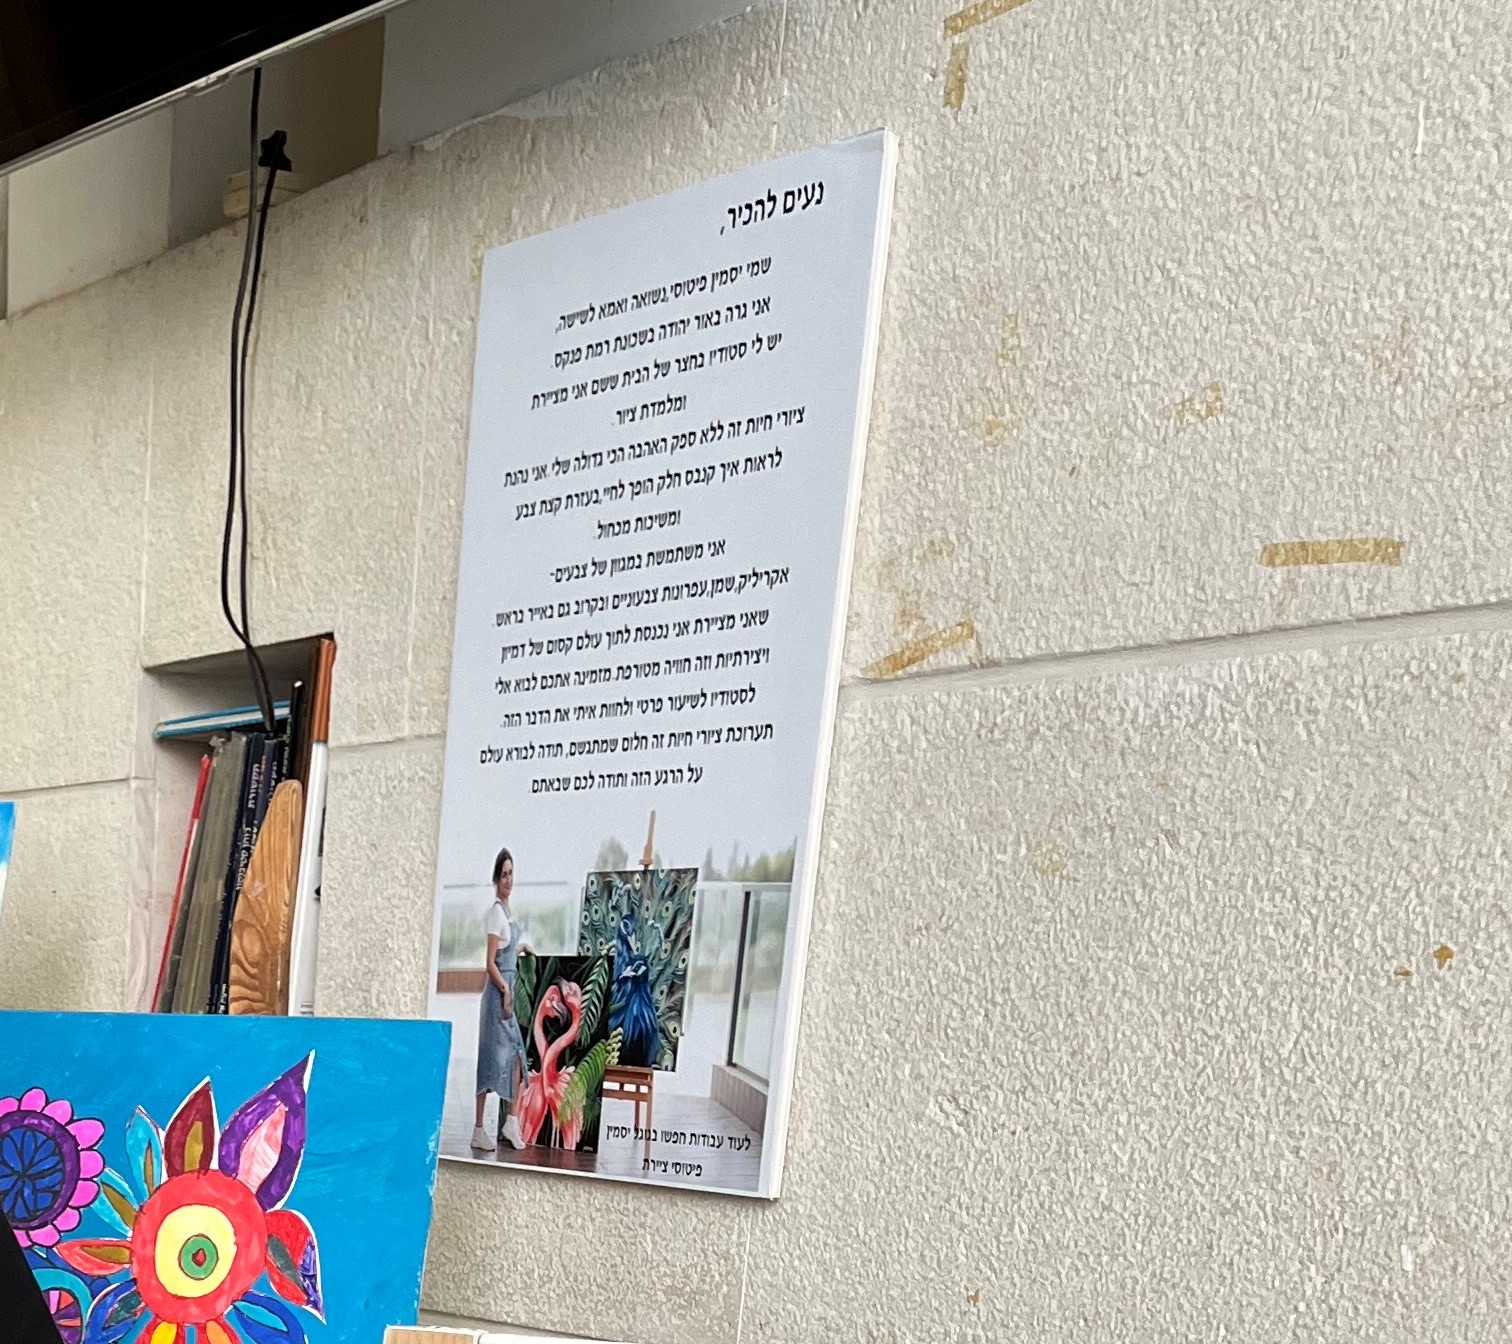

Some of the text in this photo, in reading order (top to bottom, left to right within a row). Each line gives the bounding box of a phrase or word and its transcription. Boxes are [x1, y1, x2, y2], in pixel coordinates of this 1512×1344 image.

[781, 180, 824, 214] נעים
[745, 255, 772, 278] שמי
[709, 264, 743, 293] יסמין
[597, 296, 628, 320] ואמא
[724, 301, 747, 323] גרה
[751, 294, 771, 316] אני
[657, 317, 691, 341] יהודה
[693, 308, 721, 330] באור
[584, 338, 610, 360] רמת
[612, 326, 655, 353] בשכונת
[530, 332, 782, 410] יש לי סטודיו בחצר של הבית ששם אני מציירת
[639, 392, 687, 420] ומלמדת
[776, 405, 805, 426] ציורי
[699, 419, 724, 445] ללא
[726, 419, 742, 439] זה
[743, 413, 773, 435] חיות
[627, 436, 667, 460] האהבה
[669, 430, 697, 455] ספק
[572, 449, 603, 472] גדולה
[606, 446, 625, 464] הכי
[741, 445, 783, 475] לראות
[684, 464, 716, 486] קנבס
[718, 458, 740, 483] איך
[627, 477, 654, 501] הופך
[655, 468, 681, 496] חלק
[514, 500, 537, 521] צבע
[538, 496, 562, 516] קצת
[633, 509, 681, 533] ומשיכות
[645, 542, 704, 568] משתמשת
[707, 538, 726, 557] אני
[590, 556, 607, 577] של
[609, 553, 642, 577] במגוון
[572, 595, 609, 617] ובקרוב
[611, 586, 659, 610] צבעוניים
[556, 601, 571, 618] גם
[500, 608, 769, 664] שאני מציירת אני נכנסת לתוך עולם קסום של דמיון
[663, 656, 692, 675] חוויה
[693, 654, 712, 671] וזה
[714, 646, 770, 669] ויצירתיות
[494, 675, 512, 695] אלי
[513, 671, 538, 693] לבוא
[539, 671, 571, 690] אתכם
[636, 696, 663, 714] פרטי
[666, 687, 707, 712] לשיעור
[709, 681, 756, 707] לסטודיו
[524, 708, 551, 725] הדבר
[552, 706, 570, 723] את
[572, 704, 597, 721] איתי
[598, 695, 633, 719] ולחוות
[620, 730, 648, 752] חלום
[650, 732, 665, 749] זה
[666, 730, 693, 748] חיות
[695, 727, 723, 745] ציורי
[724, 722, 773, 743] תערוכת
[479, 744, 504, 764] עולם
[504, 740, 535, 762] לבורא
[537, 742, 563, 758] תודה
[573, 769, 595, 791] לכם
[597, 771, 628, 789] ותודה
[630, 770, 651, 786] הזה
[653, 767, 684, 786] הרגע
[686, 761, 703, 784] על
[606, 1124, 630, 1140] יסמין
[633, 1125, 657, 1142] בגוגל
[689, 1132, 724, 1149] עבודות
[727, 1134, 751, 1151] לעוד
[642, 1158, 702, 1177] פיטוסי ציירת
